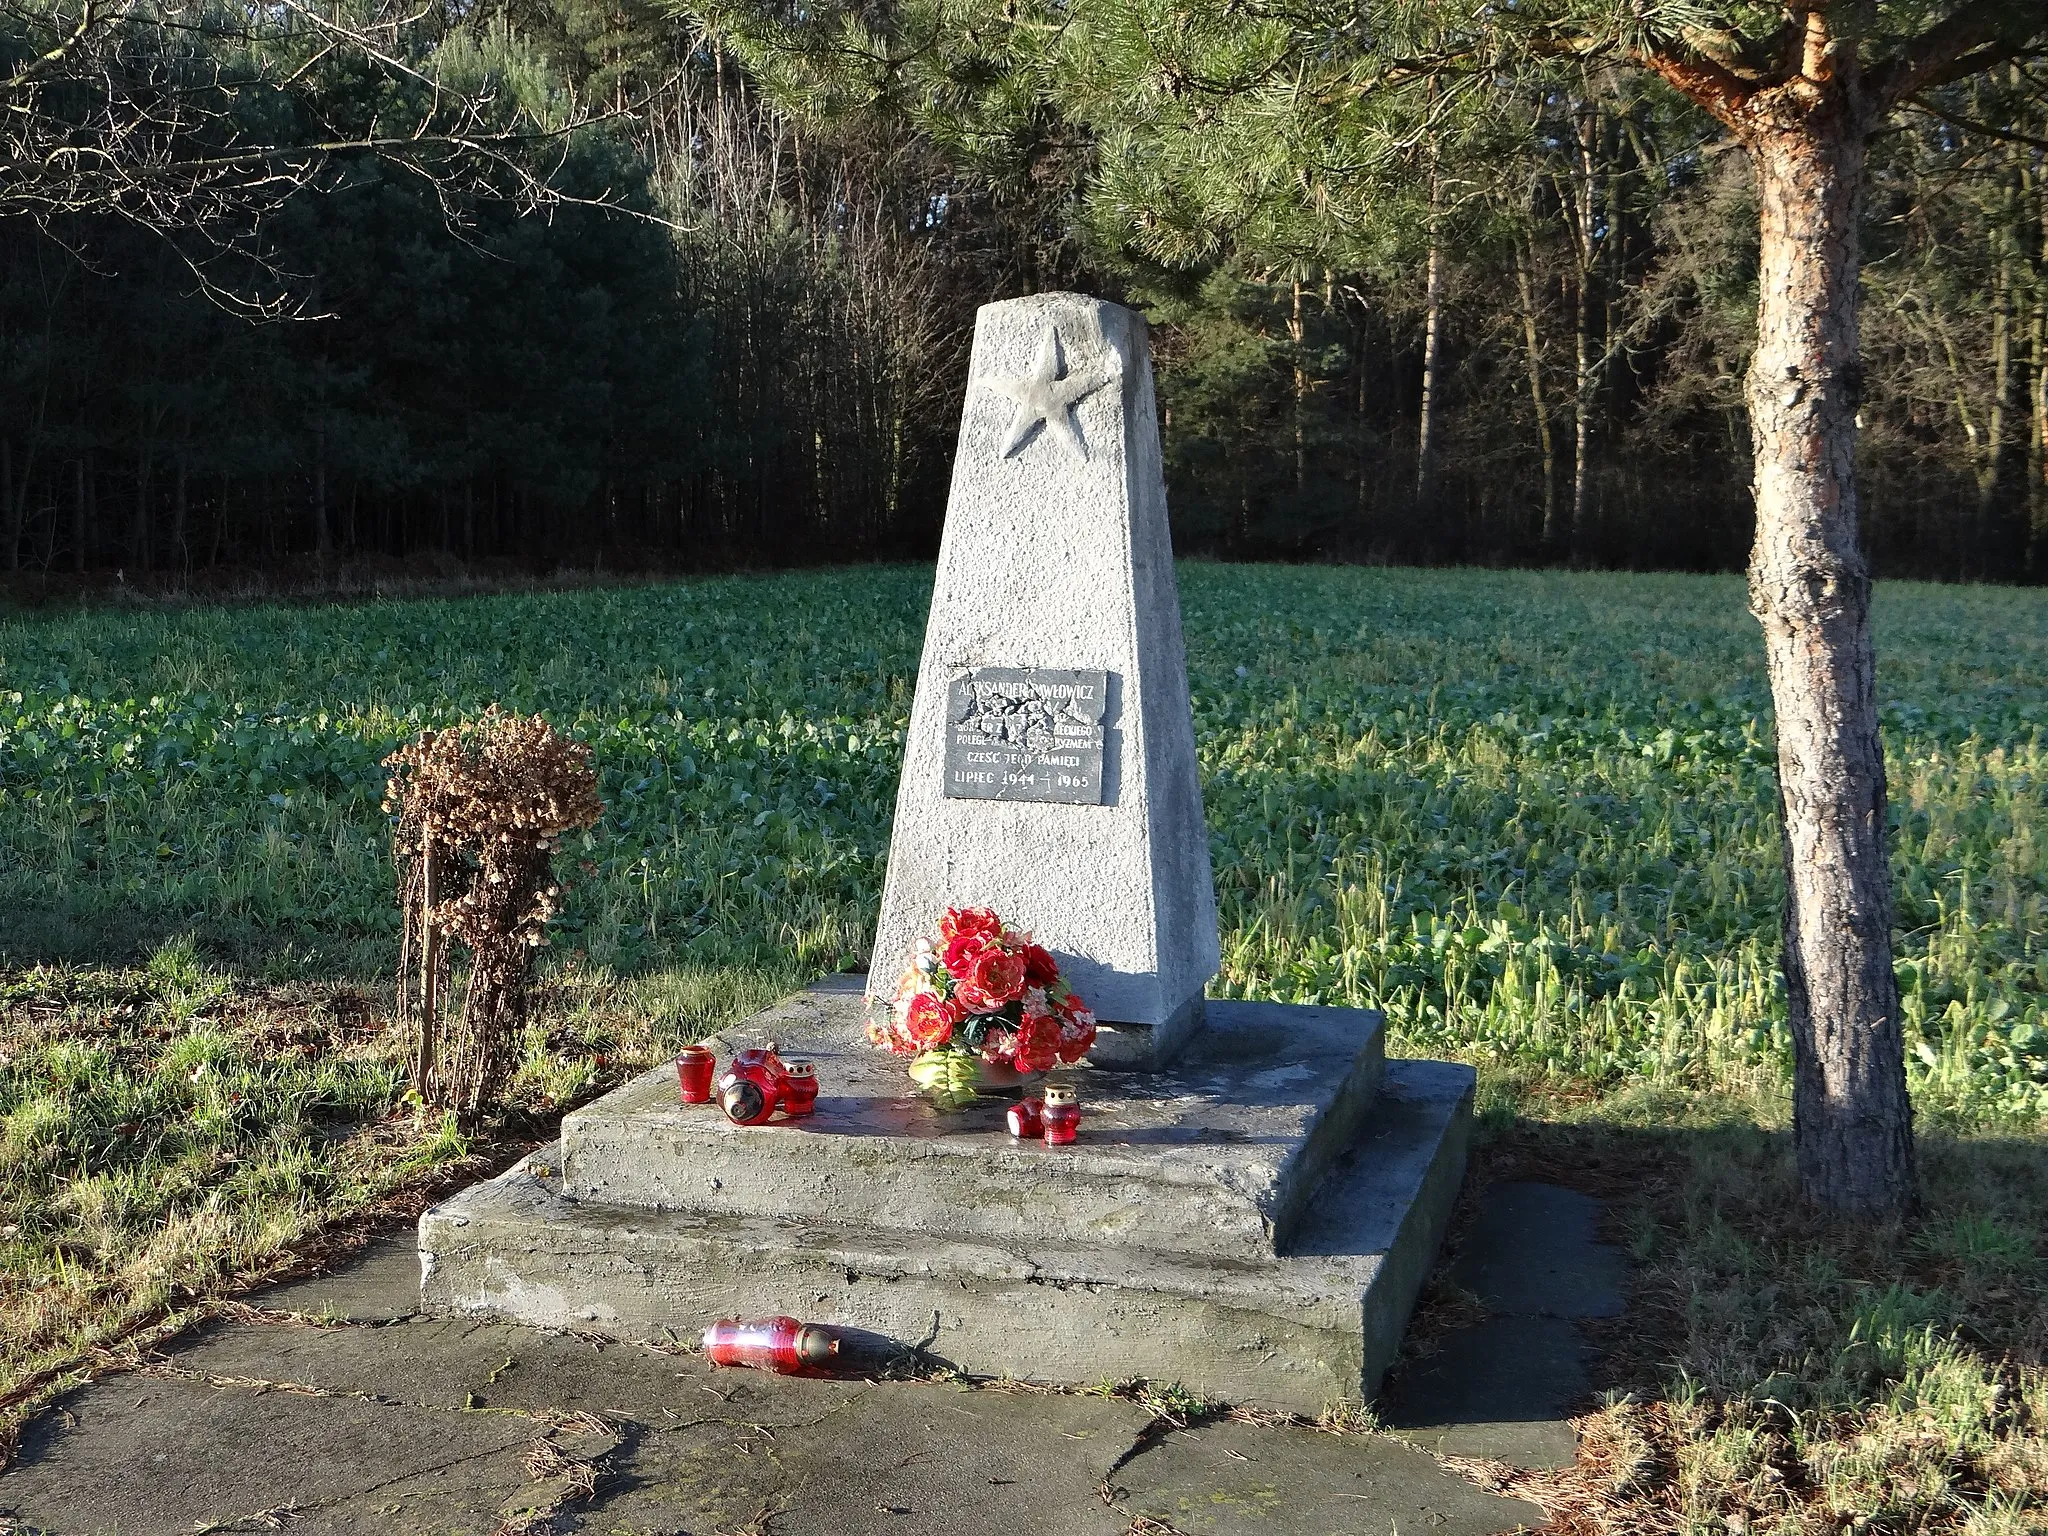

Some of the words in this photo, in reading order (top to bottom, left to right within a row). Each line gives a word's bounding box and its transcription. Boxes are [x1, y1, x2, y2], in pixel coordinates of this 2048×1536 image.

[967, 751, 1001, 764] CZEŚĆ
[1037, 754, 1080, 768] PAMIĘCI
[954, 770, 995, 784] LIPIEC
[1002, 770, 1035, 786] 1944
[1057, 773, 1089, 788] 1965
